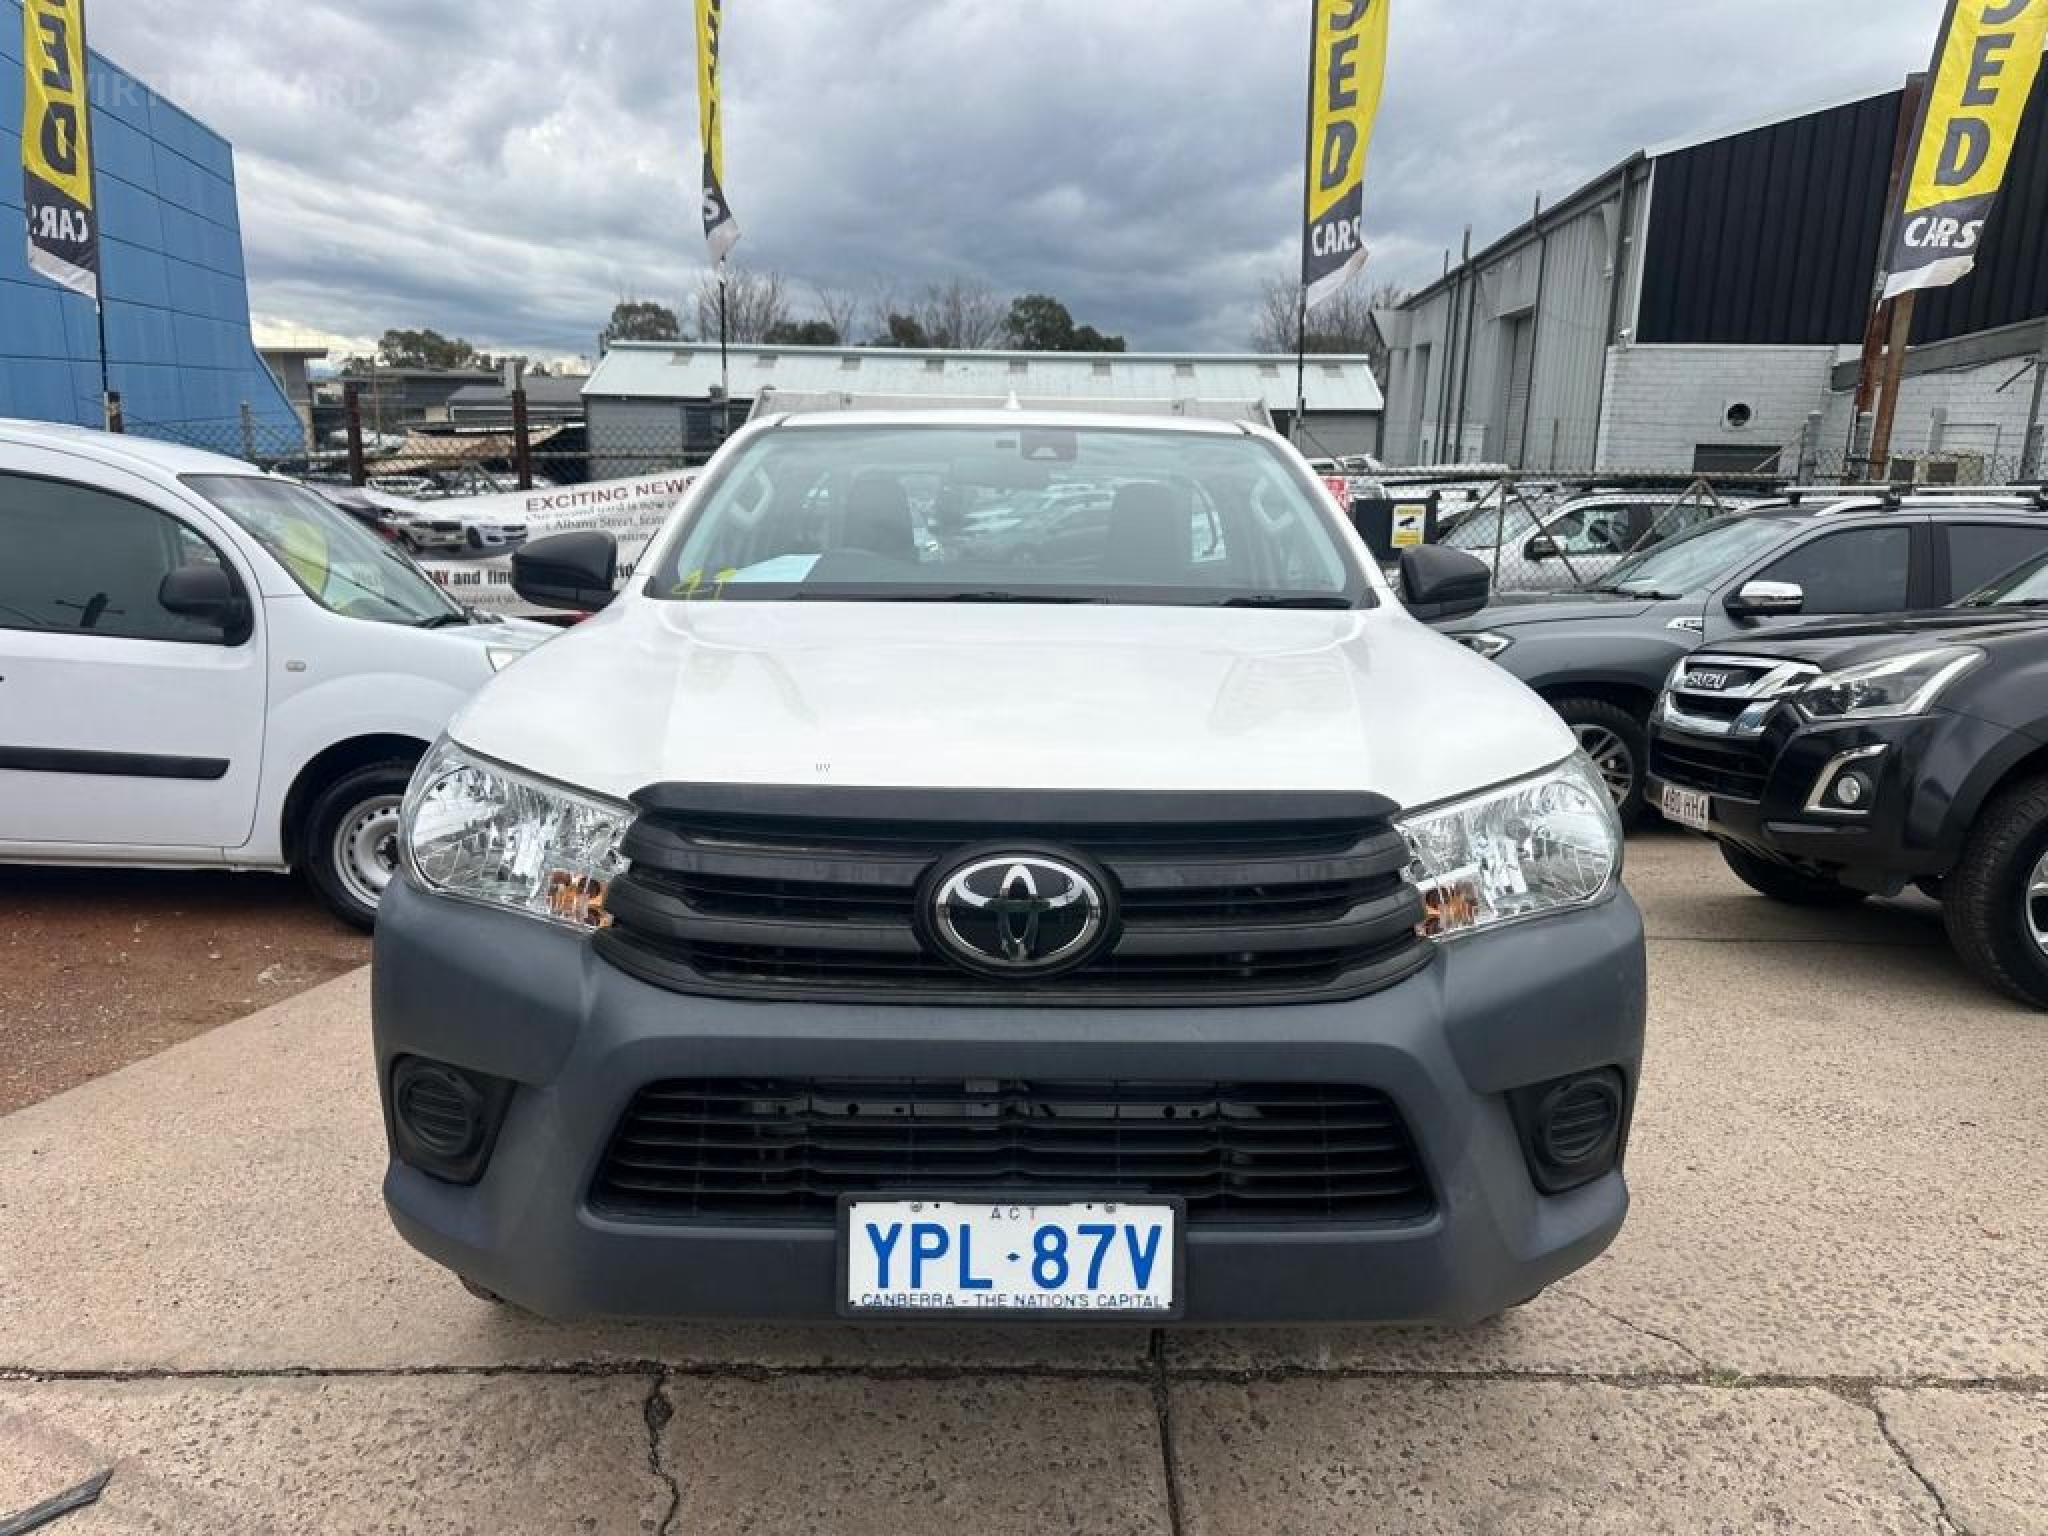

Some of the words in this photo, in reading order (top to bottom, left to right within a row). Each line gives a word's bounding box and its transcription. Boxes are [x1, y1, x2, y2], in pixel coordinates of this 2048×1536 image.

[1903, 217, 1985, 249] CARS
[526, 486, 629, 511] EXCITING
[454, 569, 481, 585] and
[1685, 671, 1729, 689] ISUZU
[861, 1293, 956, 1307] CANBERRA
[975, 1293, 1006, 1307] THE
[1014, 1294, 1089, 1308] NATION'S
[1096, 1294, 1163, 1308] CAPITAL
